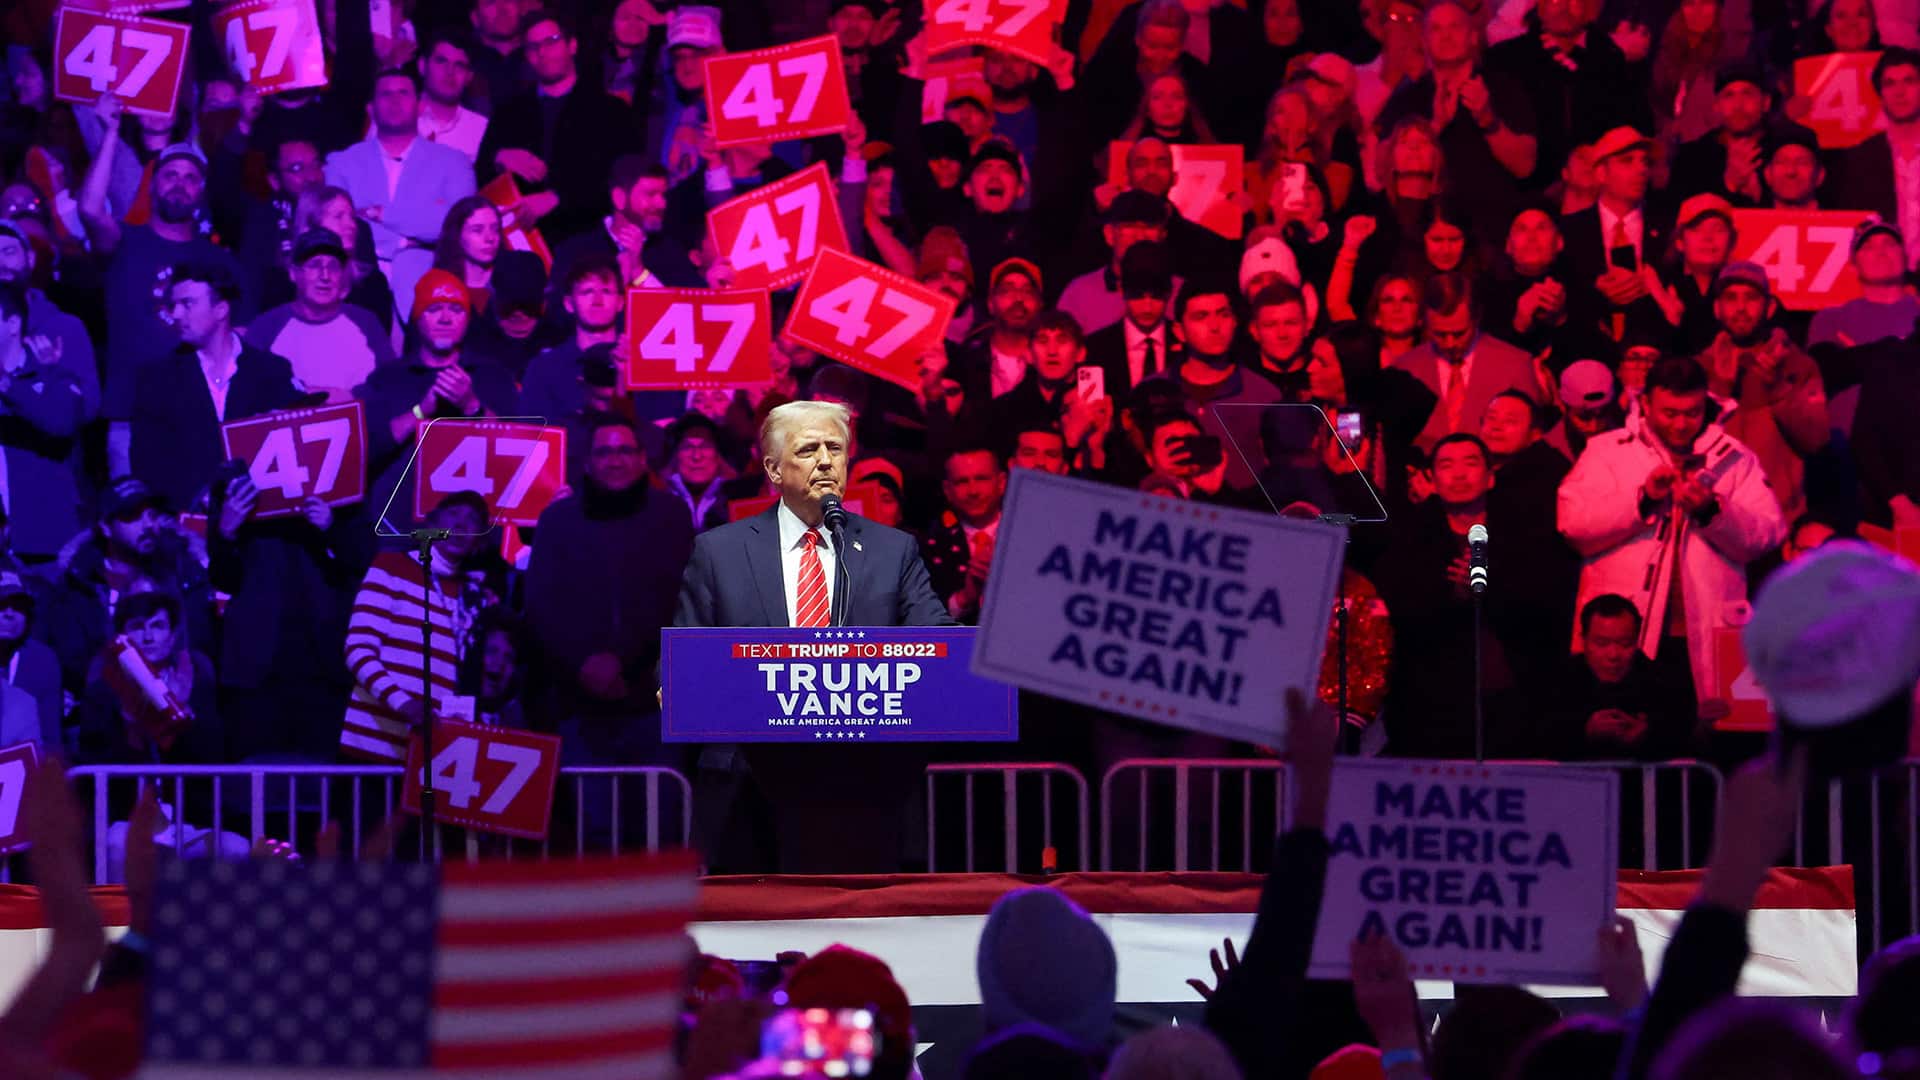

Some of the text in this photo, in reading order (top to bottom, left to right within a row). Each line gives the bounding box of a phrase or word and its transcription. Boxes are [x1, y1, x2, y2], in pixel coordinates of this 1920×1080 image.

[64, 25, 173, 97] 47
[225, 7, 299, 82] 47
[722, 52, 828, 127] 47
[1811, 67, 1871, 131] 4
[730, 183, 821, 274] 47
[1749, 225, 1855, 293] 47
[639, 303, 756, 373] 47
[810, 276, 936, 359] 47
[249, 418, 351, 498] 47
[430, 436, 549, 509] 47
[1095, 511, 1250, 574] MAKE
[1038, 545, 1284, 628] AMERICA
[740, 644, 935, 657] TEXT TRUMP TO 88022
[1064, 594, 1247, 662] GREAT
[758, 663, 922, 692] TRUMP
[777, 693, 903, 716] VANCE
[1050, 634, 1242, 706] AGAIN!
[420, 736, 542, 814] 47
[1375, 782, 1525, 822] MAKE
[1331, 822, 1571, 868] AMERICA
[1360, 867, 1538, 907] GREAT
[1357, 910, 1543, 952] AGAIN!
